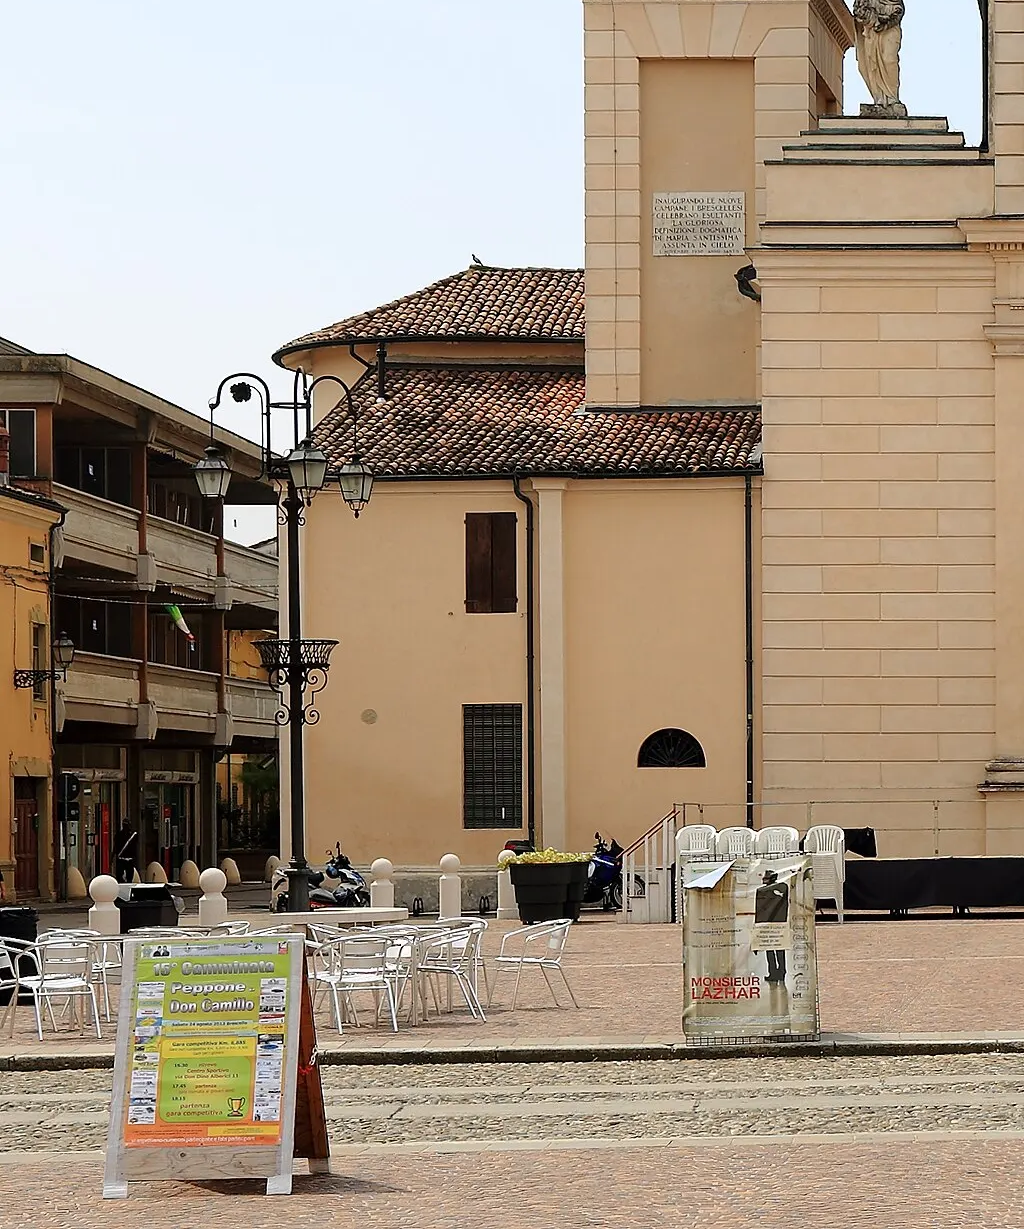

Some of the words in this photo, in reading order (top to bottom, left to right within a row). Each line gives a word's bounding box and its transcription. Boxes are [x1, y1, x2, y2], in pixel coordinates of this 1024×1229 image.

[182, 960, 275, 976] Camminata
[692, 976, 760, 987] MONSIEUR
[171, 982, 246, 996] Peppone
[692, 987, 760, 1000] LAZHAR
[170, 999, 197, 1013] Don
[201, 998, 254, 1013] Camillo
